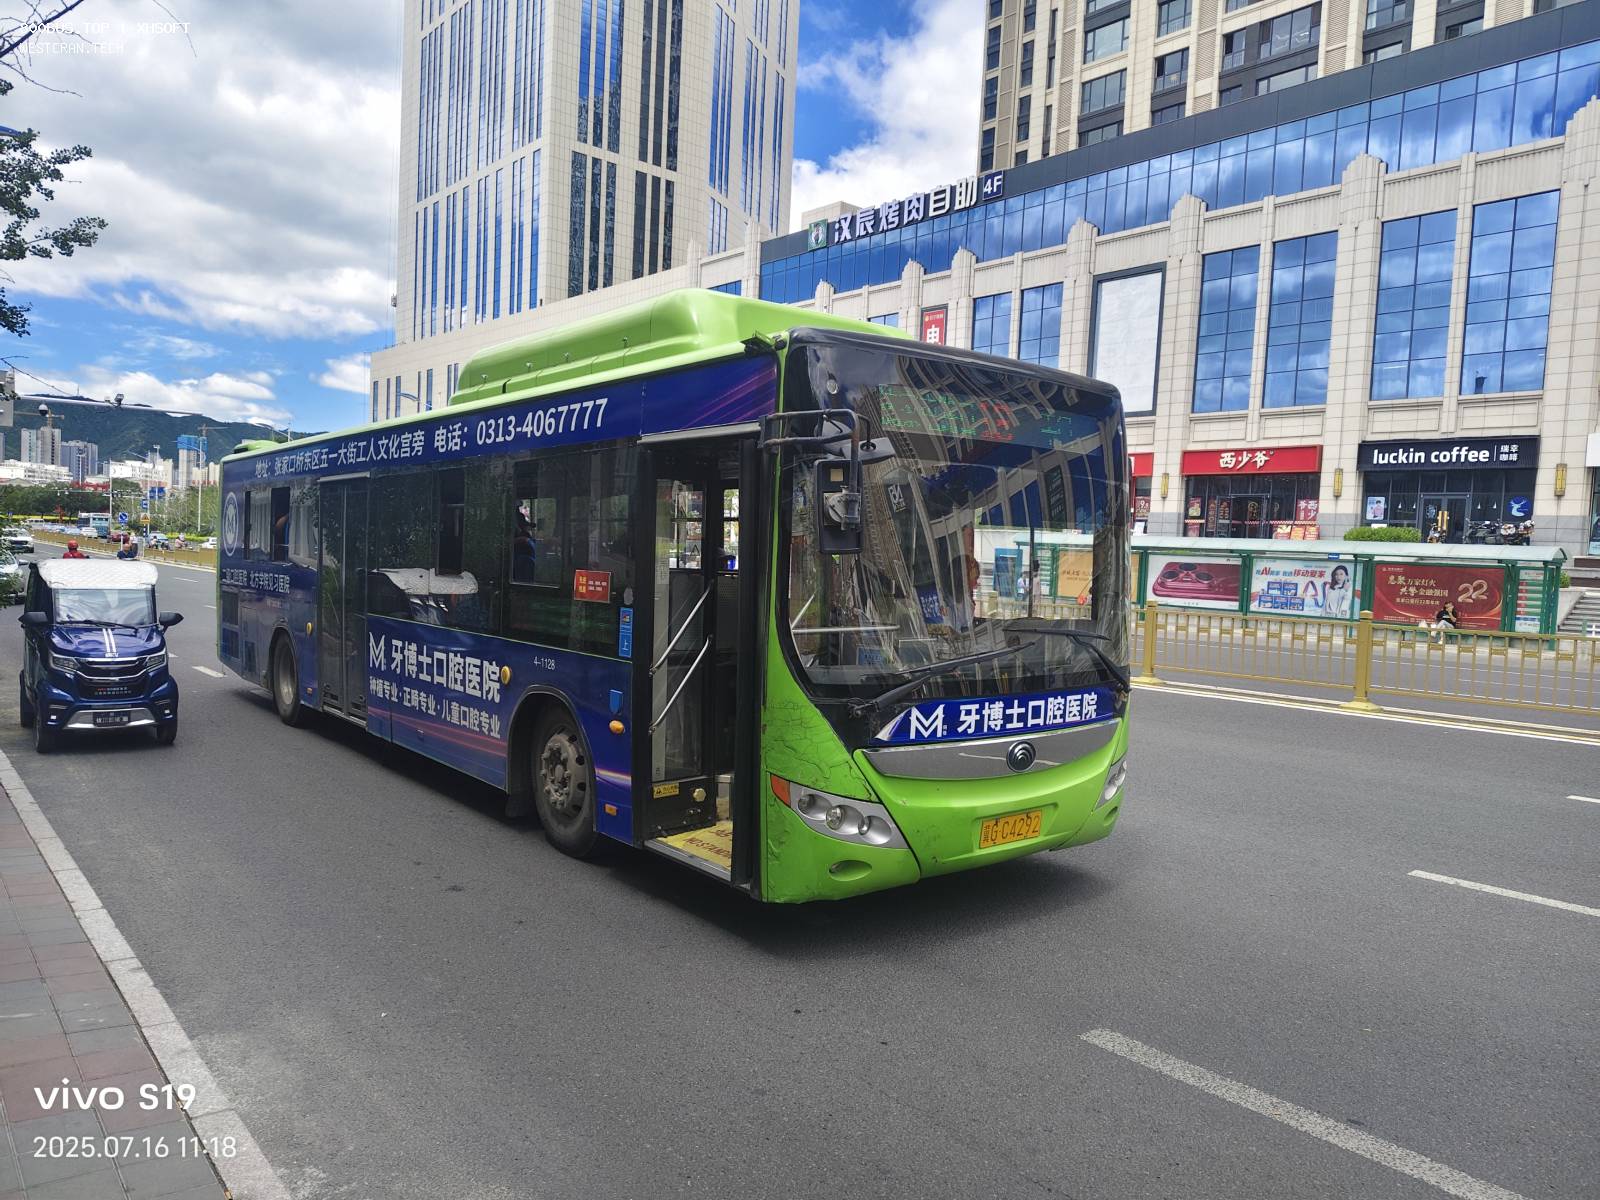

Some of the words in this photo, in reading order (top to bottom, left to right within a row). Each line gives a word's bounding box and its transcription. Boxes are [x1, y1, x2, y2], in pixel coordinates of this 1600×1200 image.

[983, 176, 1002, 195] 4F
[834, 176, 977, 243] 汉辰烤肉自助
[1219, 451, 1270, 469] 西少爷
[1373, 448, 1425, 464] luckin
[1431, 446, 1490, 463] coffee
[1457, 579, 1489, 604] 22
[390, 639, 500, 704] 牙博士口腔医院
[533, 656, 556, 671] 4-1128
[957, 691, 1098, 735] 牙博士口腔医院
